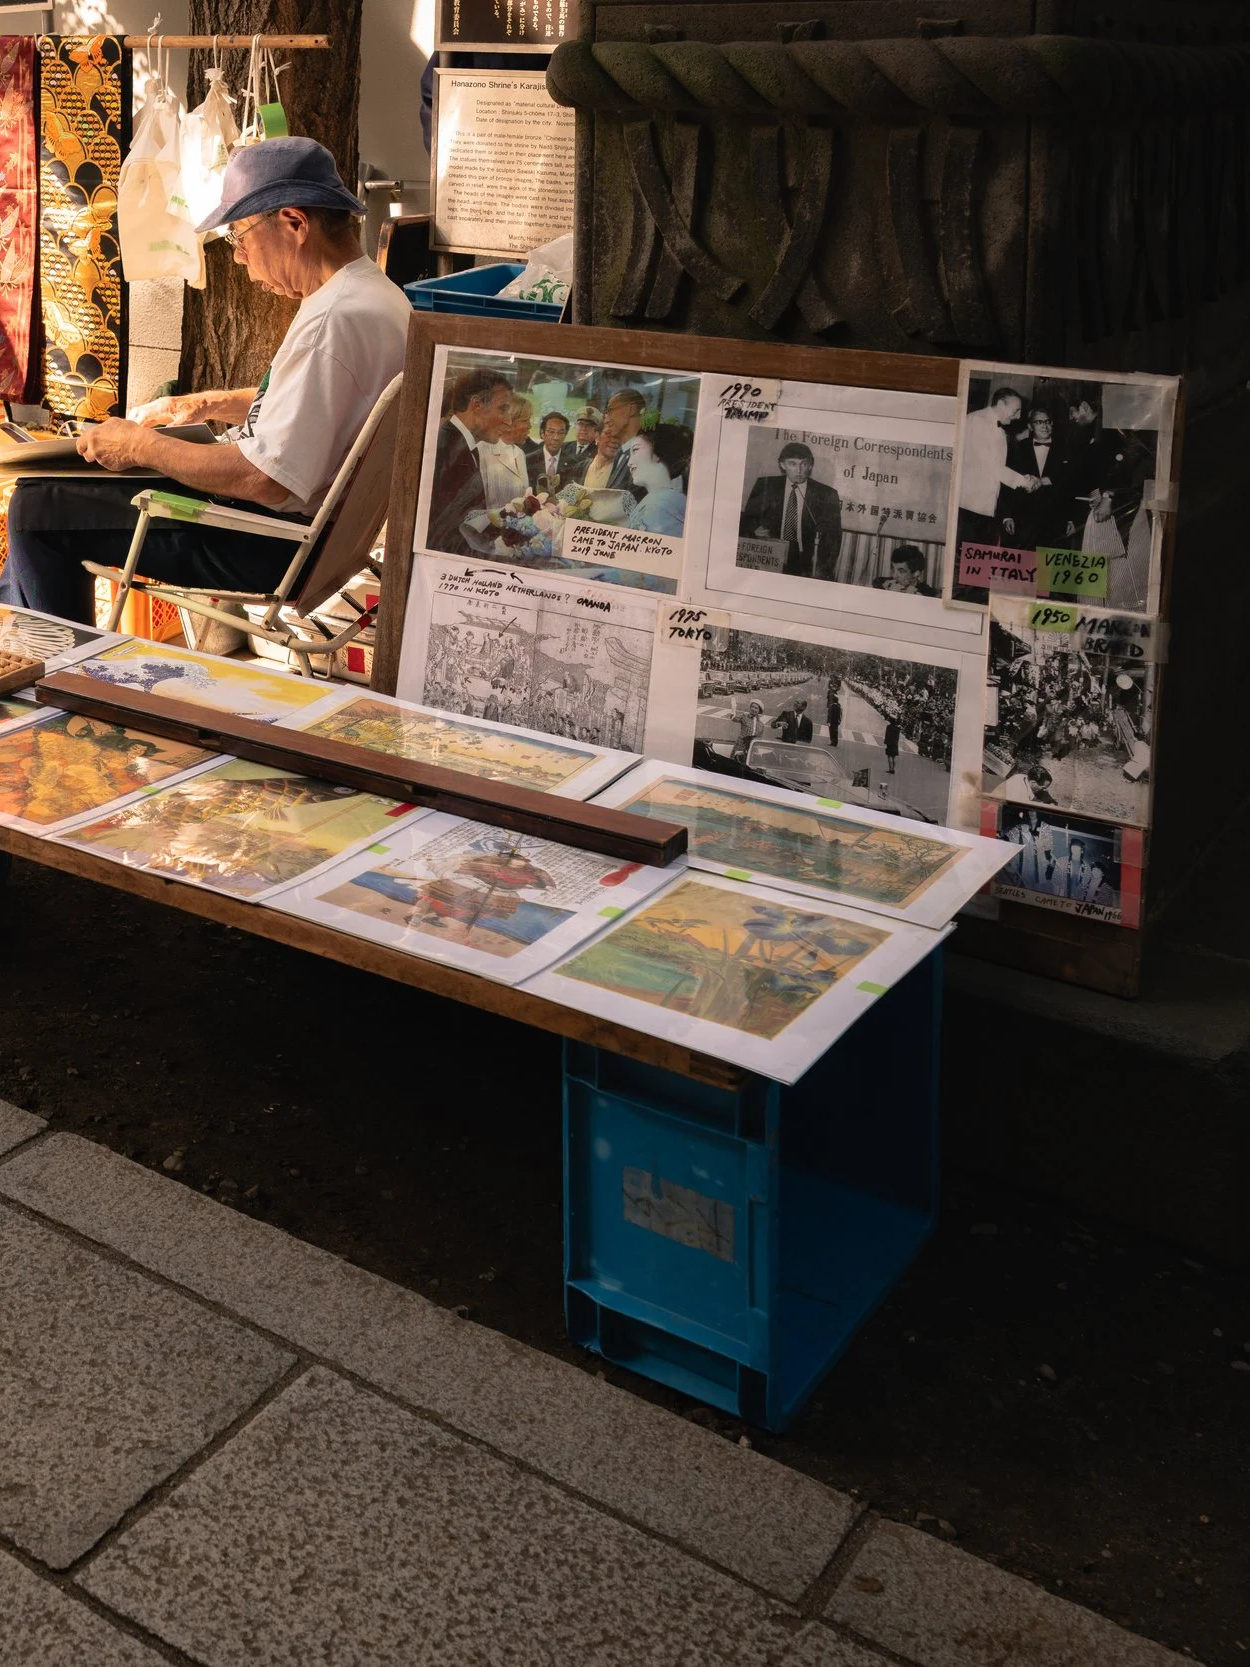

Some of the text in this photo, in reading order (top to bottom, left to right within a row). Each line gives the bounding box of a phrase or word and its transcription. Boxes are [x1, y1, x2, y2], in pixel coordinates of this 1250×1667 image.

[451, 80, 546, 91] Hanazono Shrine's Karajis
[719, 382, 762, 400] 1990
[717, 398, 777, 412] PRESIDENT
[774, 427, 953, 462] The Foreign Correspondents
[843, 465, 899, 488] of Japan
[573, 525, 663, 546] PRESIDENT MACRON
[570, 545, 617, 560] 2019 JUNE
[571, 535, 595, 545] CAME
[596, 539, 607, 547] TO
[644, 546, 674, 556] KYOTO
[965, 546, 1022, 565] SAMURAI
[1045, 552, 1106, 569] VENEZIA
[965, 565, 1037, 583] IN ITALY
[1052, 570, 1099, 586] 1960
[440, 573, 447, 581] 3
[448, 573, 471, 584] DUTCH
[471, 579, 503, 589] HOLLAND
[576, 597, 612, 613] ORANDA
[475, 588, 500, 597] KYOTO
[669, 608, 708, 624] 1975
[1032, 608, 1071, 626] 1950
[669, 626, 712, 641] TOKYO
[1034, 895, 1058, 907] CAME
[1074, 903, 1105, 916] JAPAN
